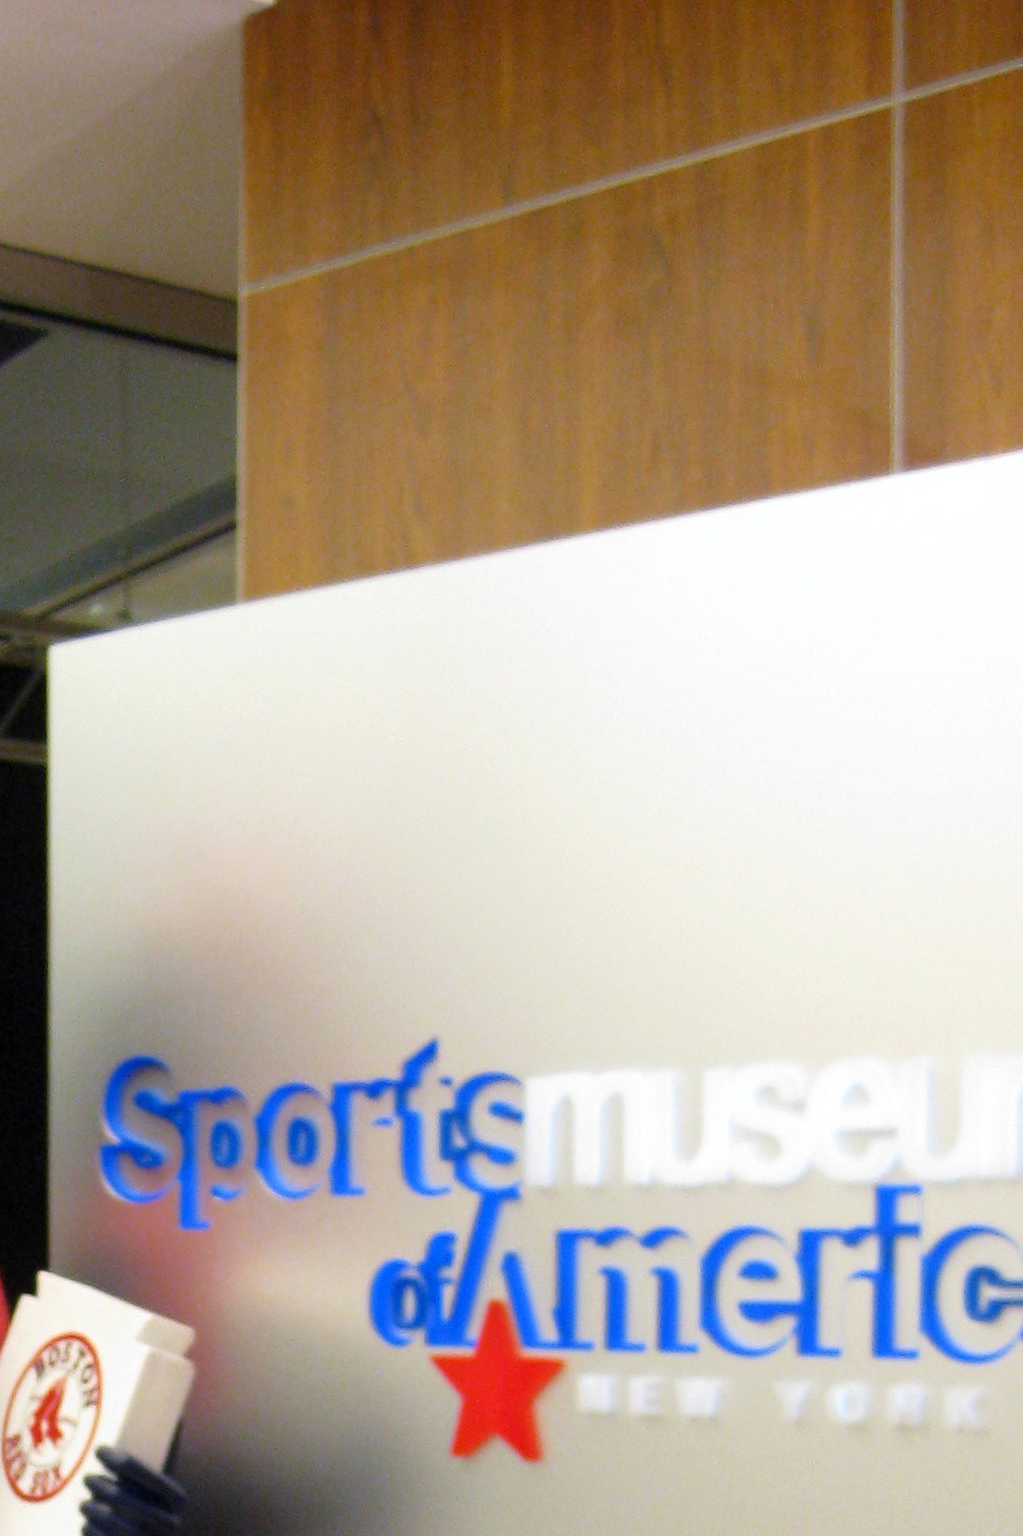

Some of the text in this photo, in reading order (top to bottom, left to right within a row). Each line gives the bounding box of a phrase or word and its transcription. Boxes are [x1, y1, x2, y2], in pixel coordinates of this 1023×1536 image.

[369, 1185, 1023, 1364] of Americ
[579, 1372, 989, 1429] NEW YORK
